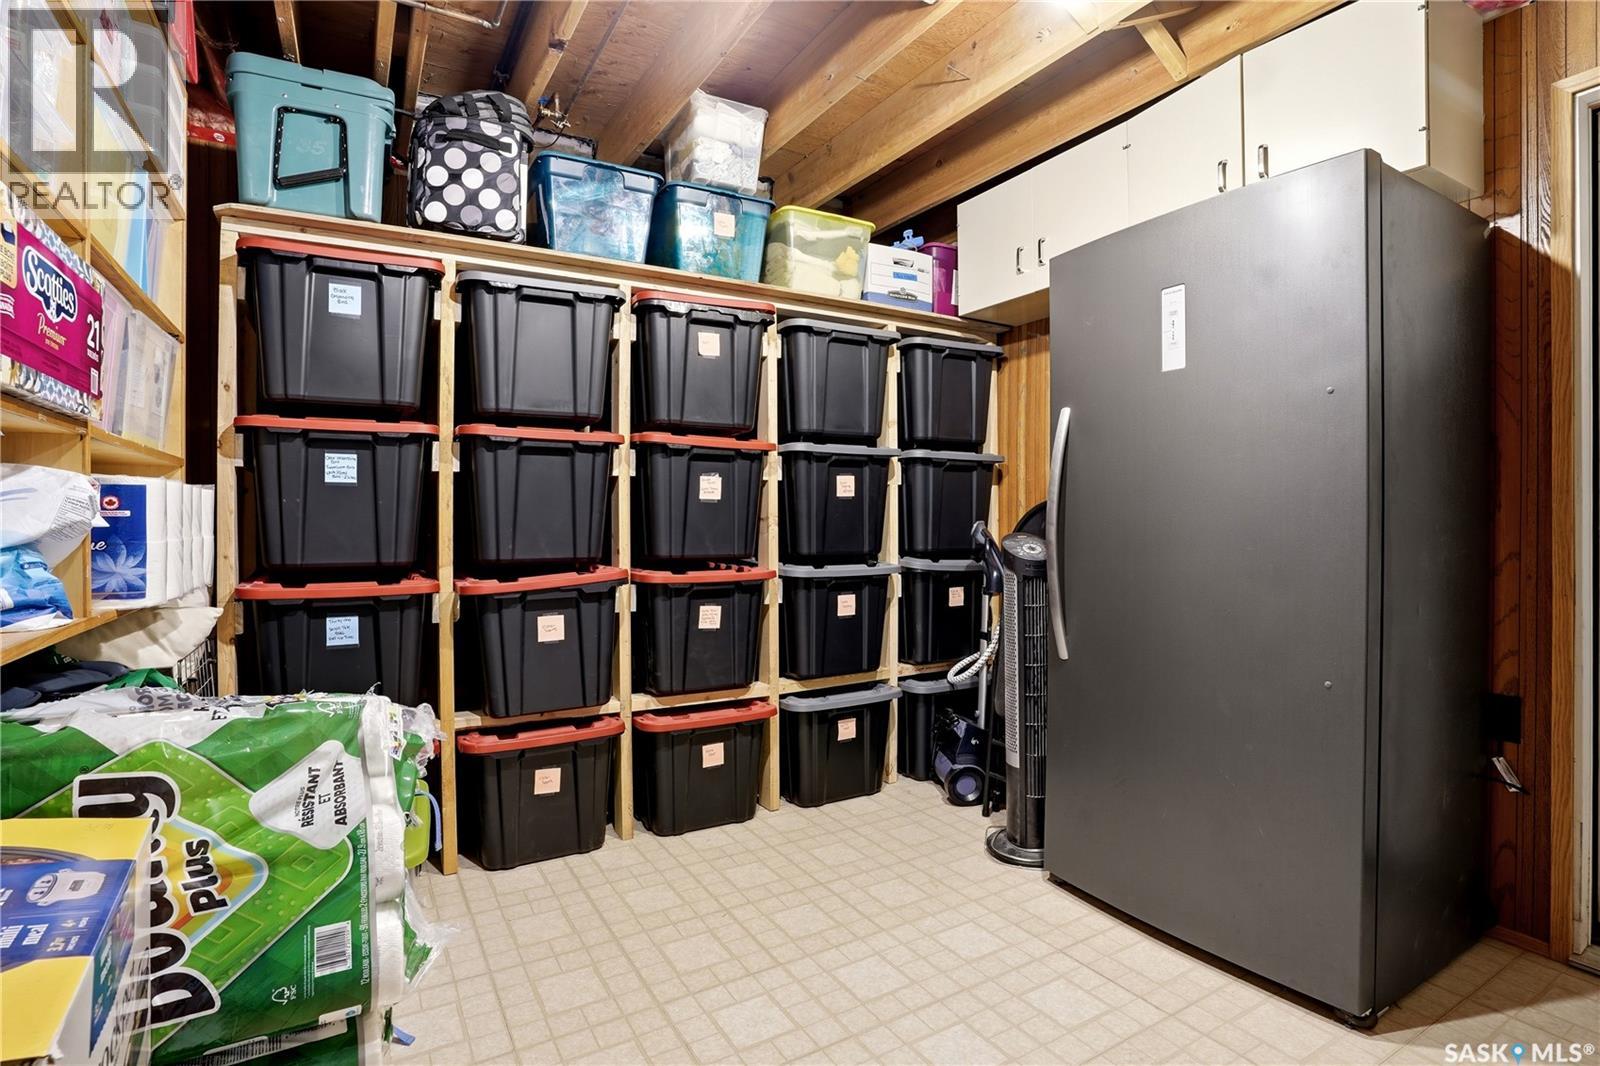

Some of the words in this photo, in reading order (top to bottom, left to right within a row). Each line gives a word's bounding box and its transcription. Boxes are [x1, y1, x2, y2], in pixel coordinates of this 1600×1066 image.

[25, 251, 75, 314] Scotties
[37, 312, 67, 346] Premium
[87, 314, 100, 351] 21
[299, 766, 321, 828] RÉSISTANT
[318, 793, 331, 805] ET
[333, 760, 347, 826] ABSORBANT
[181, 838, 229, 914] plus
